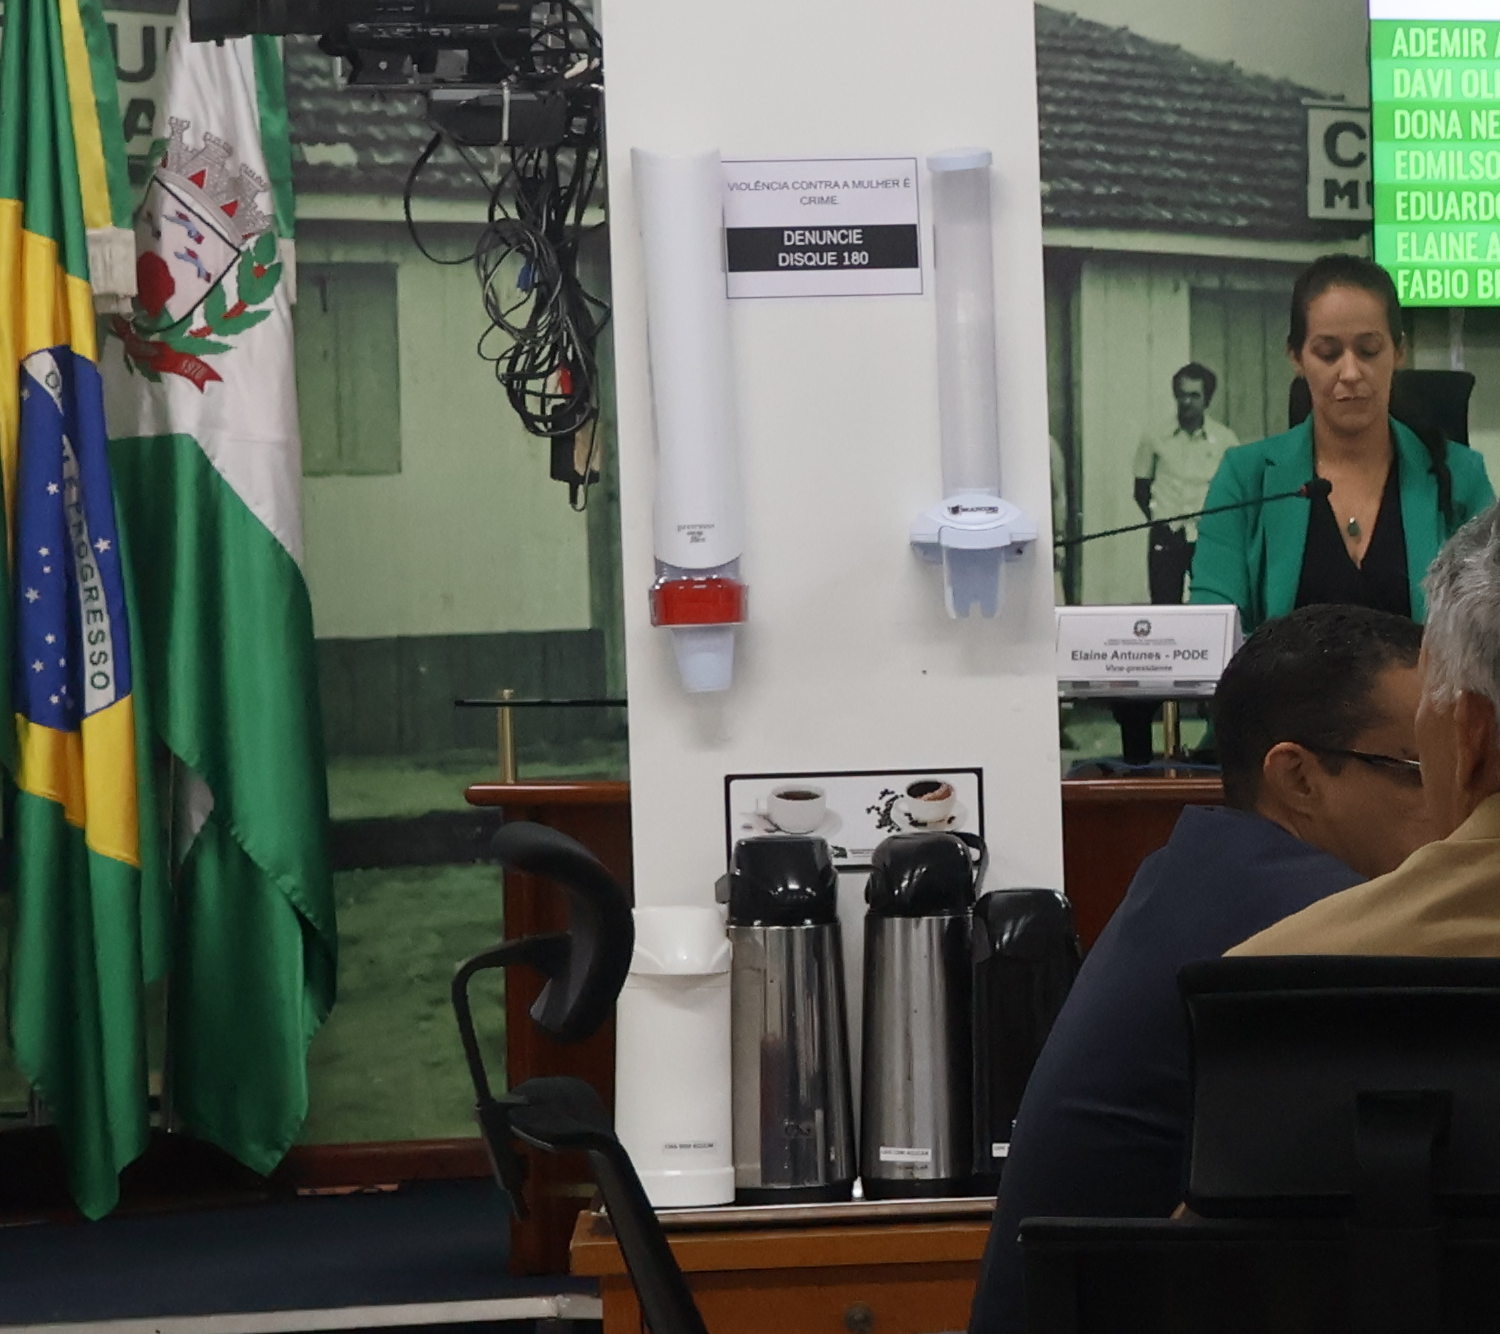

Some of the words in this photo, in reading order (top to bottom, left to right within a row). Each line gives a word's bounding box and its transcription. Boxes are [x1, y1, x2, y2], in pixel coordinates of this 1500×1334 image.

[1392, 28, 1487, 59] ADEMIR
[1393, 69, 1453, 99] DAVI
[1394, 109, 1462, 139] DONA
[728, 180, 790, 192] VIOLÊNCIA
[794, 180, 839, 191] CONTRA
[842, 180, 849, 190] A
[852, 179, 900, 190] MULHER
[784, 230, 863, 246] DENUNCIE
[1396, 231, 1477, 262] ELAINE
[778, 252, 838, 268] DISQUE
[843, 251, 869, 265] 180
[1397, 269, 1469, 301] FABIO
[67, 499, 110, 691] PROGRESSO
[1071, 650, 1107, 660] Elaine
[1111, 649, 1161, 660] Antunes
[1173, 649, 1208, 660] PODE
